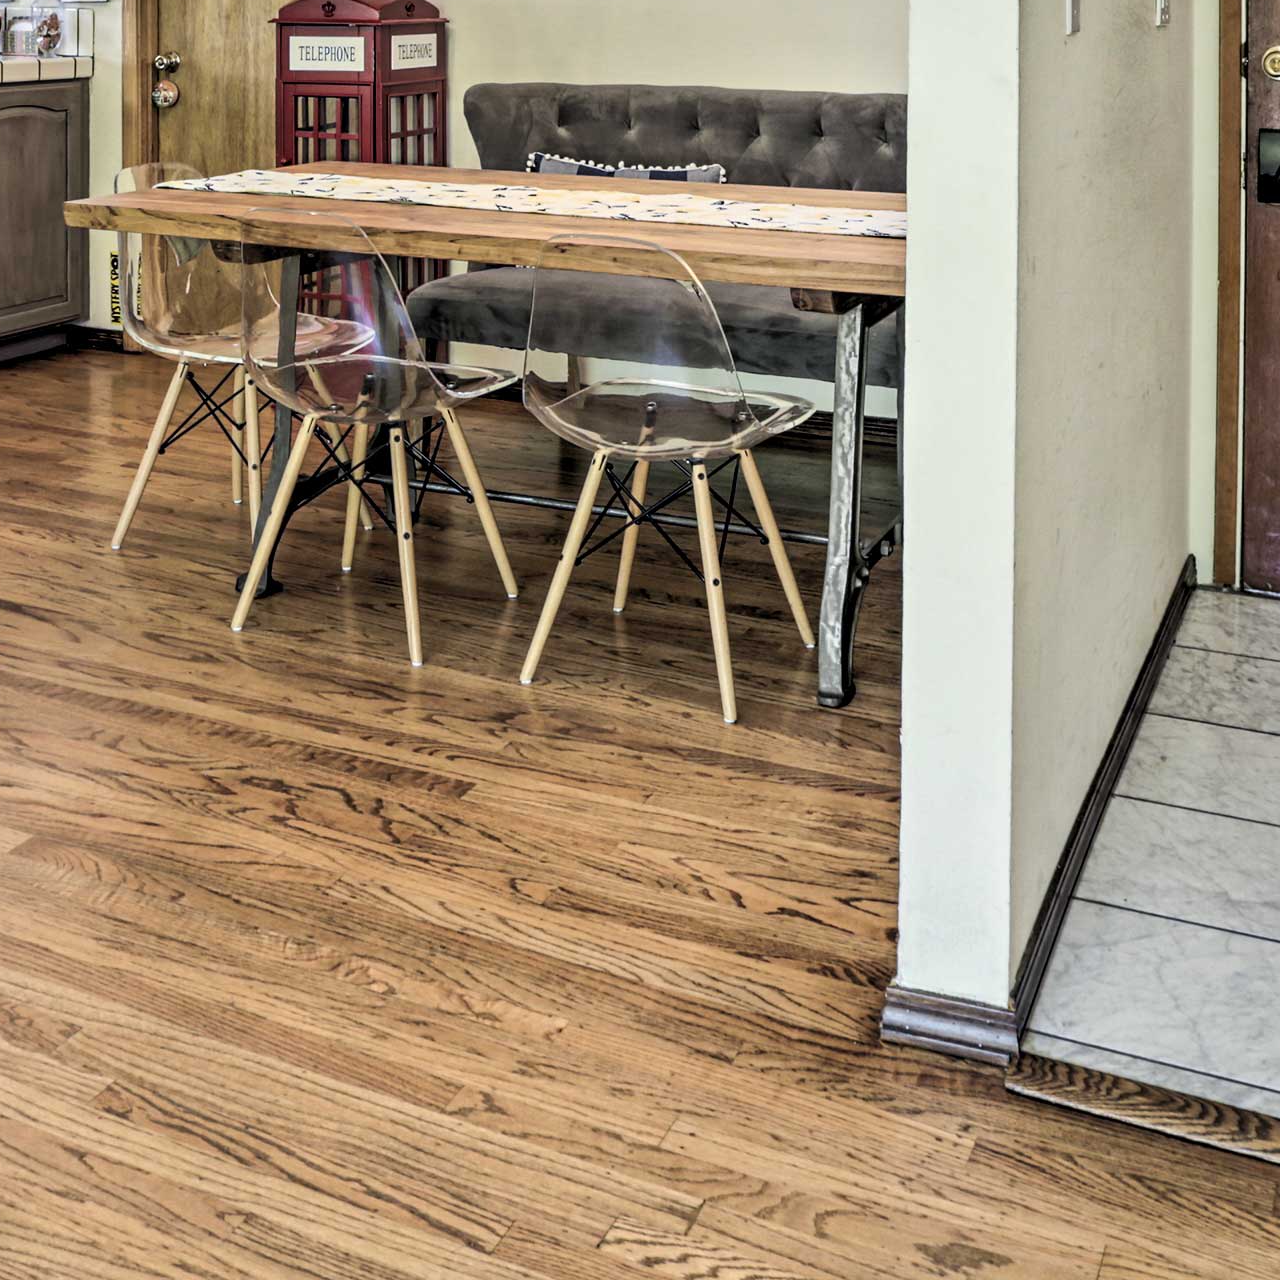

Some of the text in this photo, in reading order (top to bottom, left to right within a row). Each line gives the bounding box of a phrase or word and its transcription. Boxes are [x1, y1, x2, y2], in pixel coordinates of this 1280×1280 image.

[299, 45, 356, 62] TELEPHONE
[398, 42, 432, 60] TELEPHONE
[110, 252, 120, 323] MYSTERY SPOT
